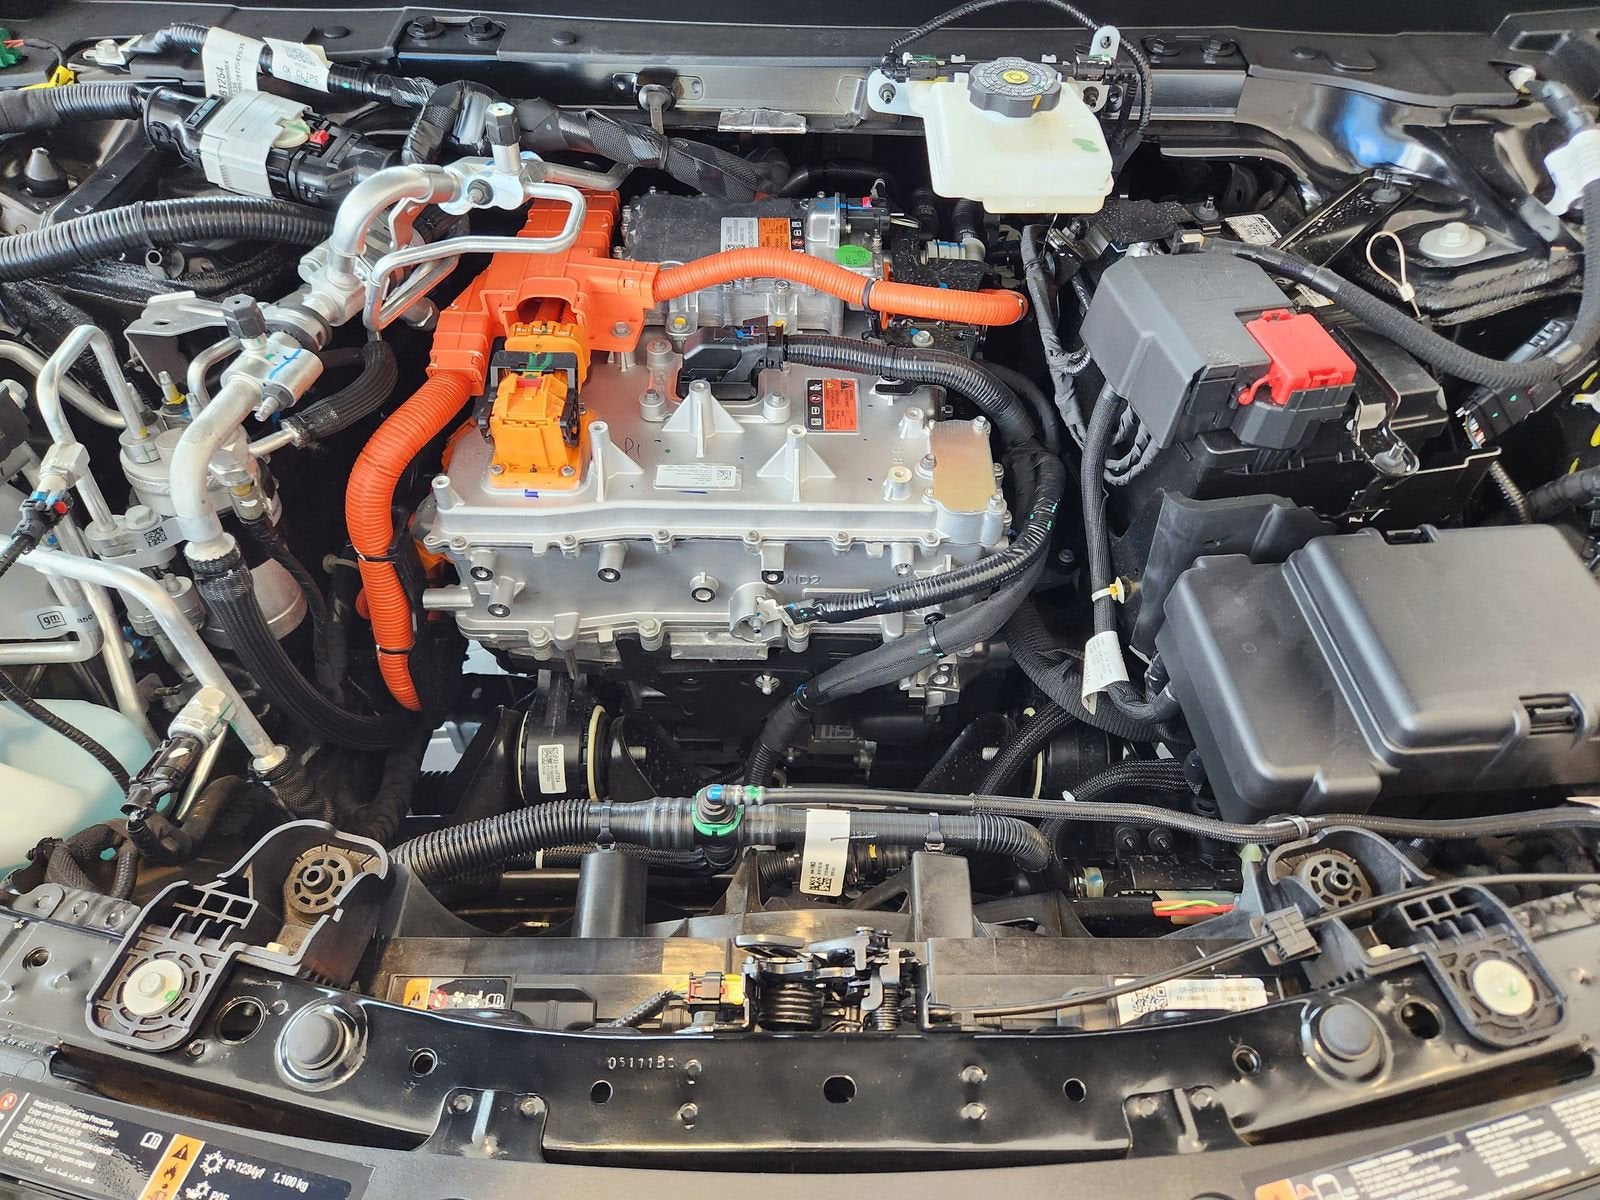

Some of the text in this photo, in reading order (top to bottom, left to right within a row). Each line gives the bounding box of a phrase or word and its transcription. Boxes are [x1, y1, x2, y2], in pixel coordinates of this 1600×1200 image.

[296, 69, 319, 83] CLIPS
[783, 574, 821, 585] ND2
[225, 1159, 310, 1193] R-1234yf 1.100 kg
